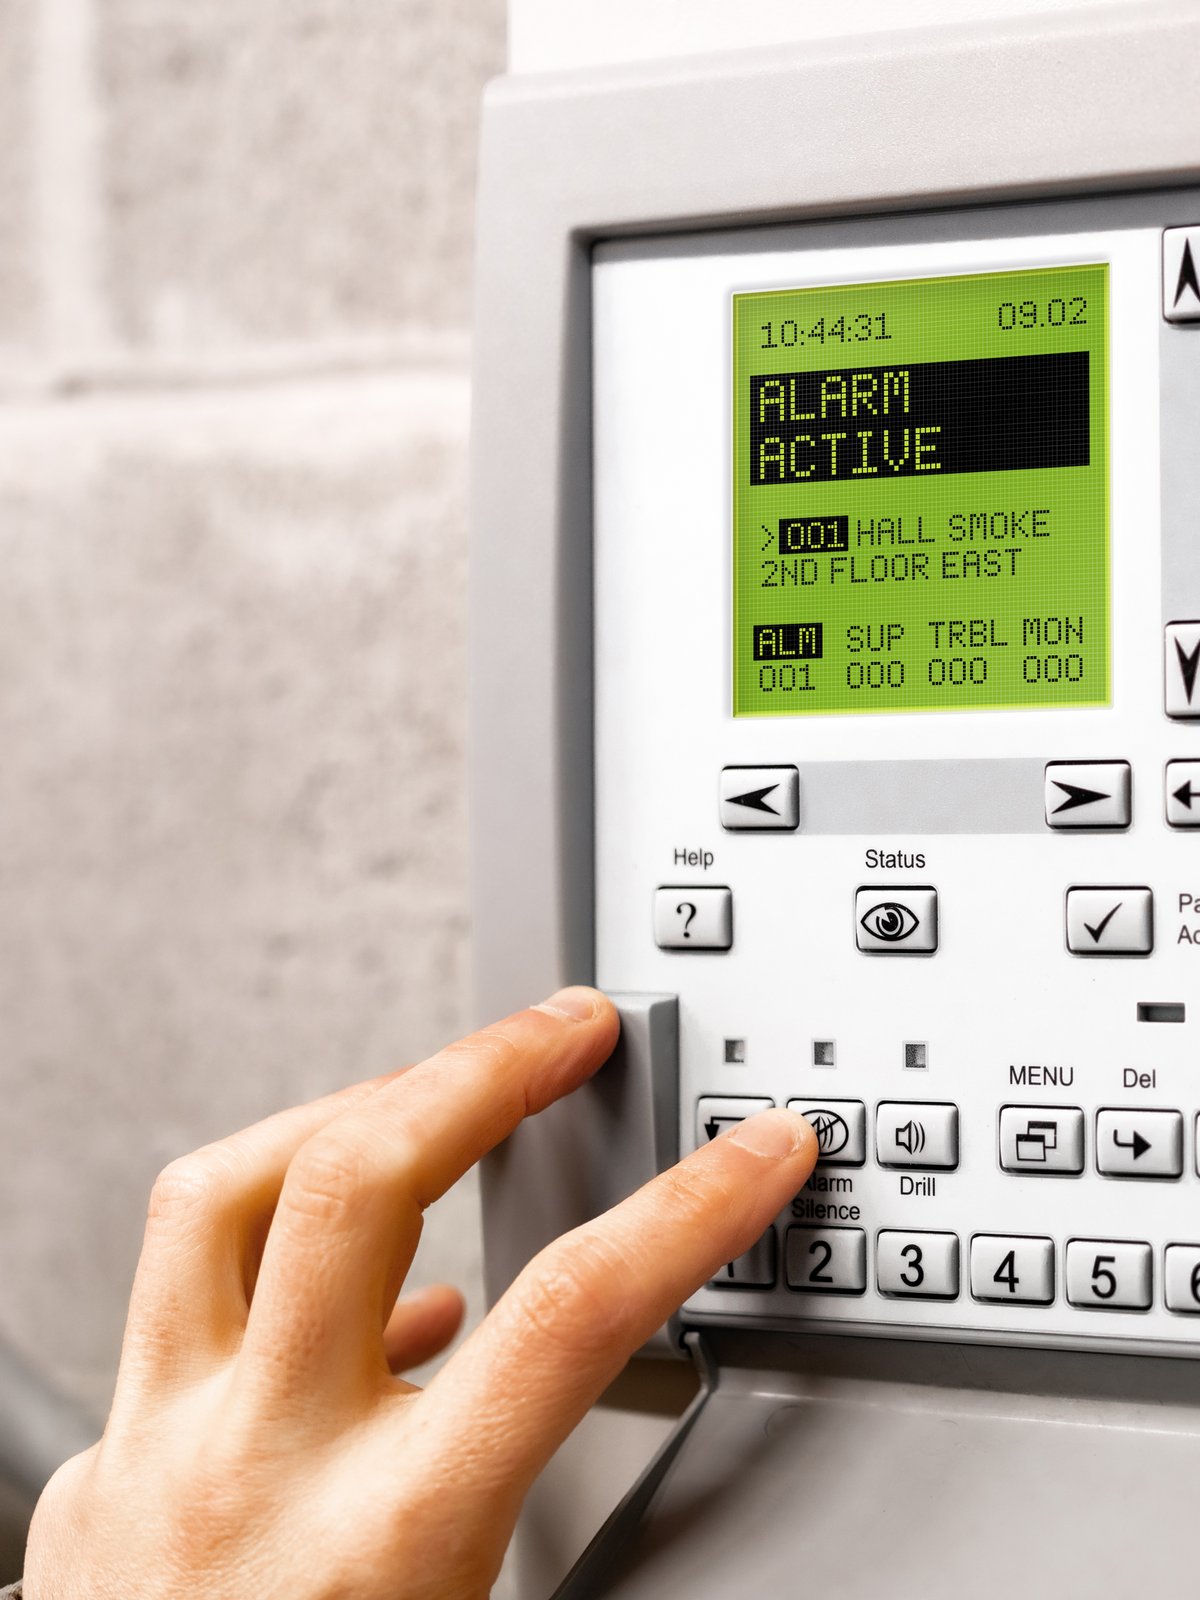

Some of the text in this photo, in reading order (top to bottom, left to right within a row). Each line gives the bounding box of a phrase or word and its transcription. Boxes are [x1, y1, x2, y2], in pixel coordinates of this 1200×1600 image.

[761, 296, 1087, 349] 10:44:31 09.02
[760, 371, 909, 422] ALARM
[760, 427, 941, 479] ACTIVE
[785, 520, 845, 551] 001
[857, 516, 936, 547] HALL
[949, 509, 1051, 542] SMOKE
[761, 548, 1022, 588] 2ND FLOOR EAST
[759, 616, 1084, 656] ALM SUP TRBL MON
[759, 654, 1084, 692] 001 000 000 000
[673, 848, 715, 870] Help
[864, 849, 927, 870] Status
[1009, 1065, 1074, 1087] MENU
[1122, 1068, 1157, 1089] Del
[900, 1175, 936, 1197] Drill
[791, 1198, 861, 1221] Silence
[808, 1240, 834, 1283] 2
[900, 1244, 925, 1287] 3
[993, 1250, 1020, 1293] 4
[1091, 1255, 1118, 1299] 5
